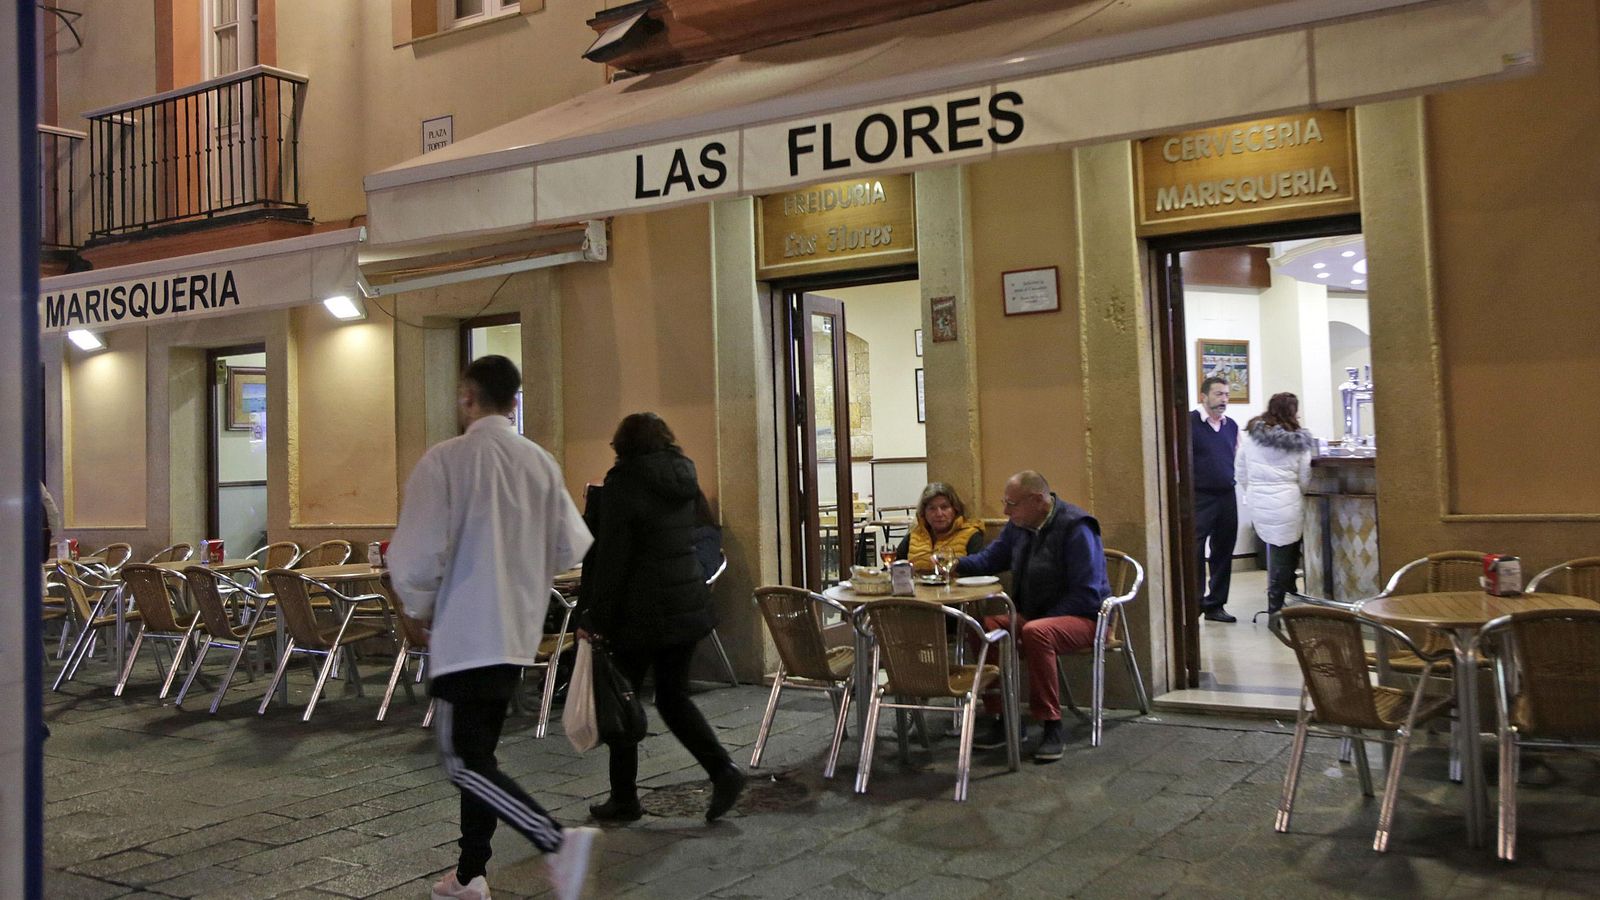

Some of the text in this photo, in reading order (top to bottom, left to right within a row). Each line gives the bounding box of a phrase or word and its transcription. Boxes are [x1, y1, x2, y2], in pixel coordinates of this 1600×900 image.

[428, 128, 447, 139] PLAZA
[635, 91, 1024, 199] LAS FLORES
[1163, 117, 1323, 163] CERVECERIA
[784, 181, 887, 216] FREIDURIA
[1155, 166, 1338, 213] MARISQUERIA
[783, 224, 892, 258] Las Flores
[45, 270, 240, 328] MARISQUERIA
